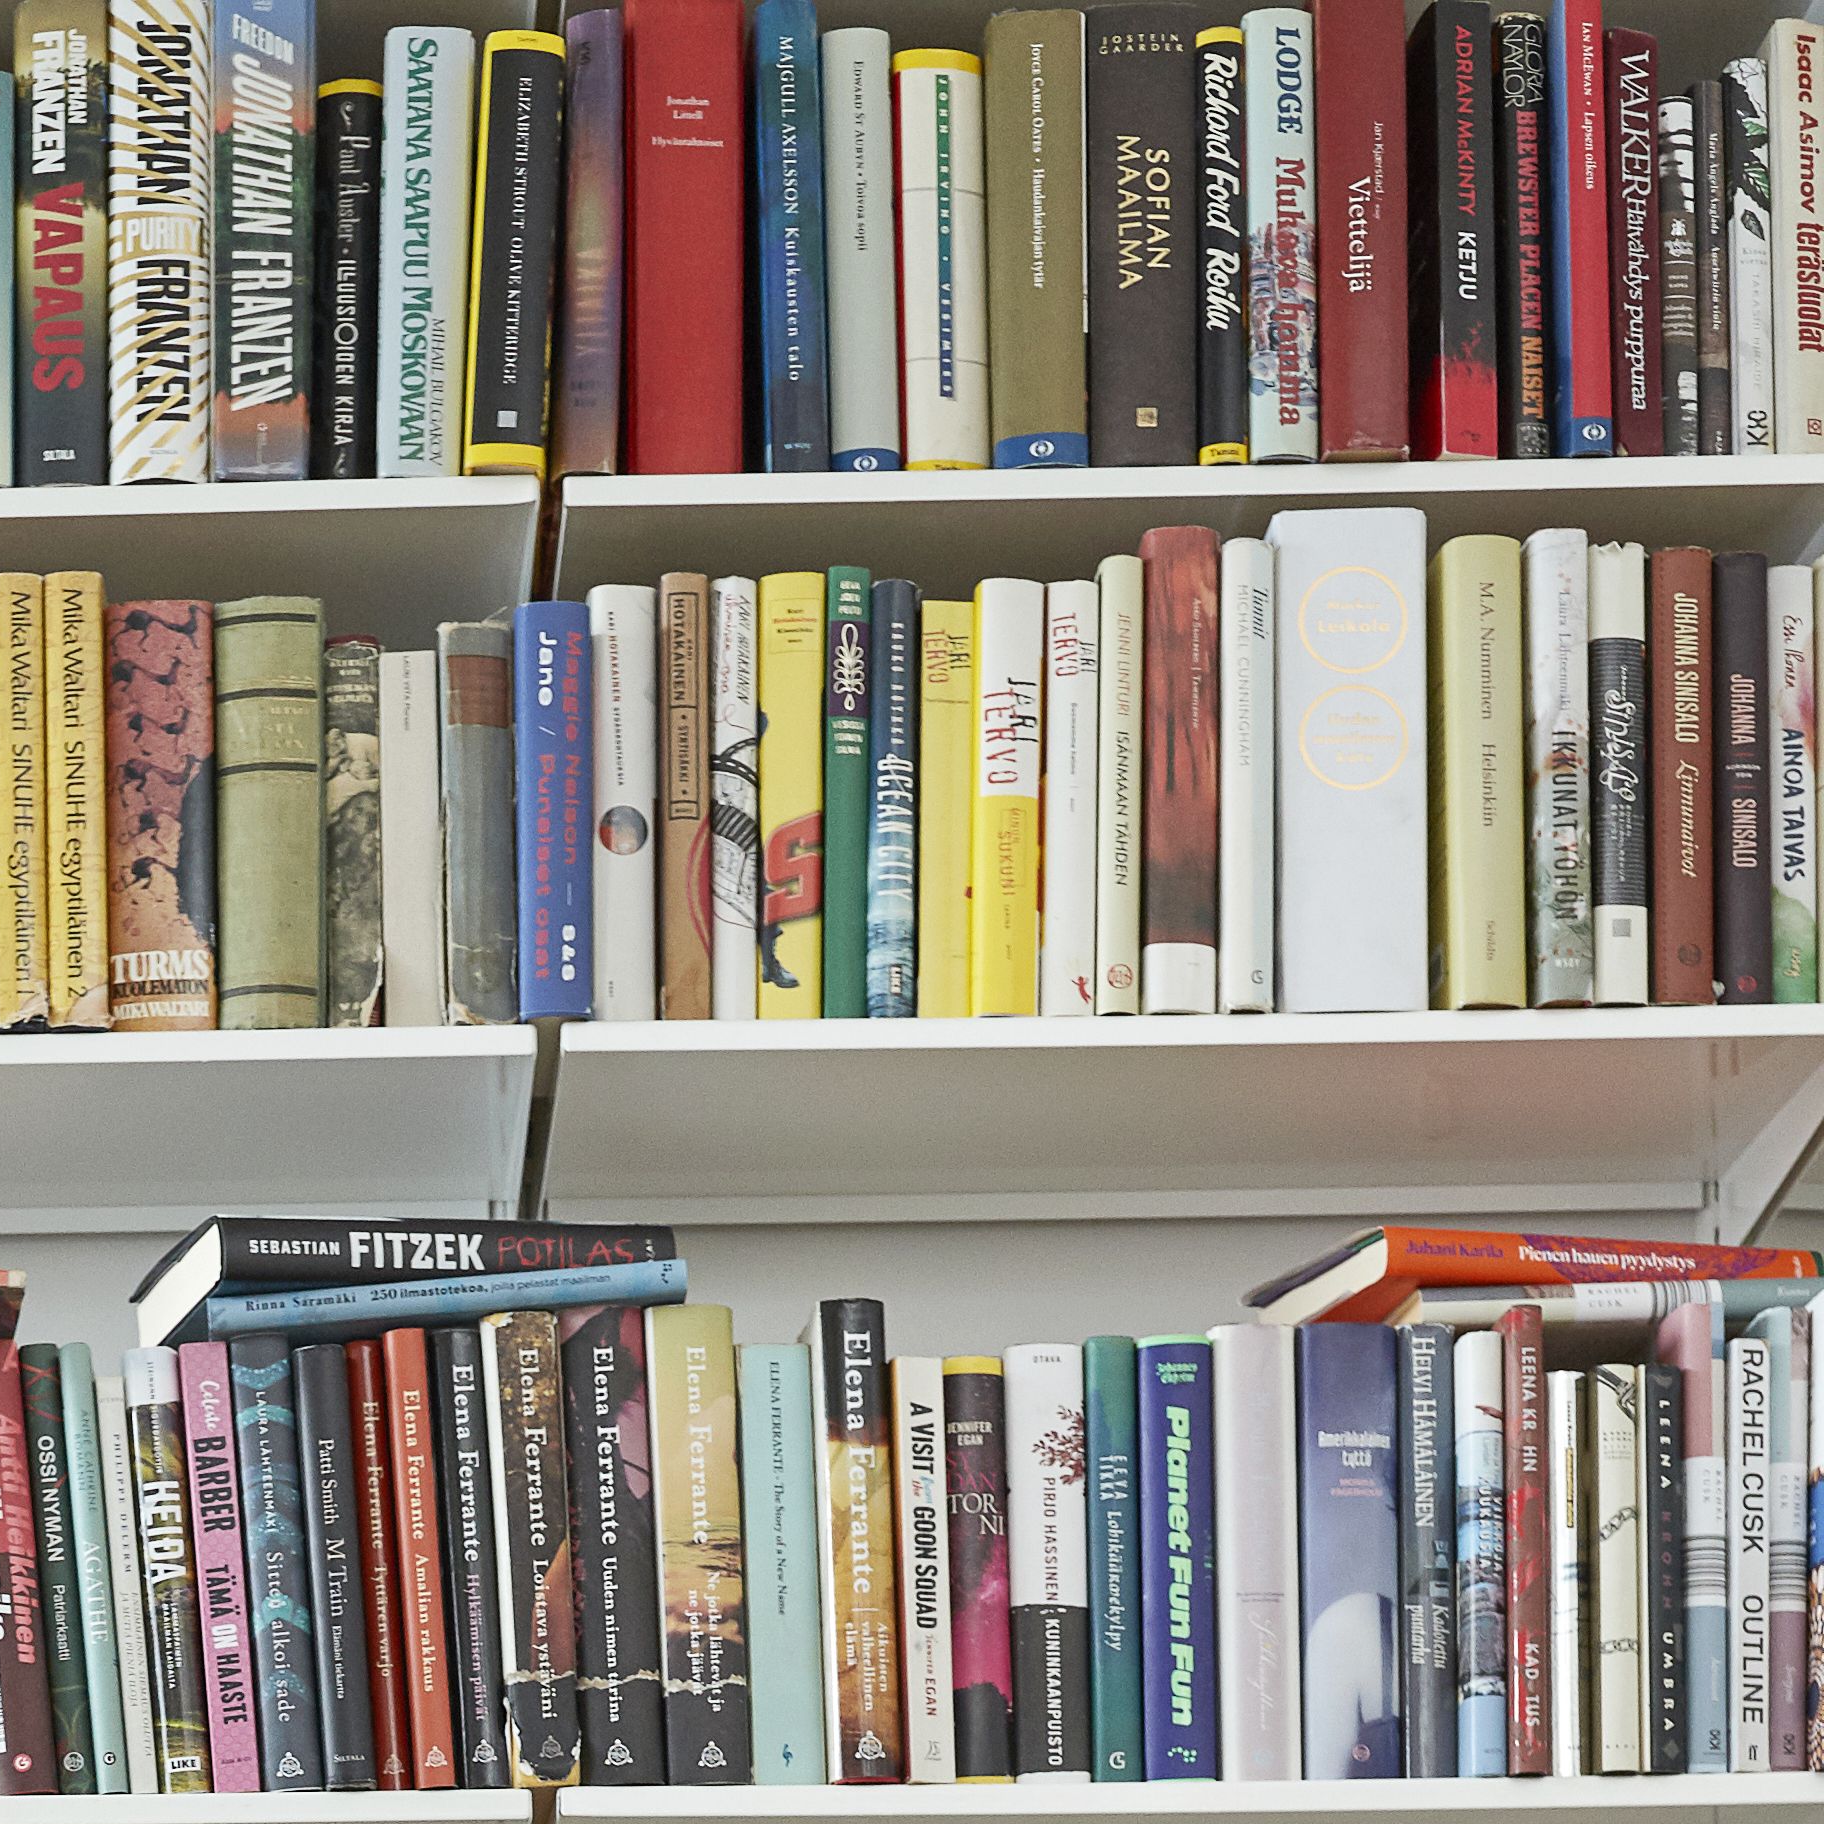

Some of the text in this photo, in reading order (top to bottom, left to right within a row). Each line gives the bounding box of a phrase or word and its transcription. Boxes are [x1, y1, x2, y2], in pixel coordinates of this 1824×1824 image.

[32, 32, 65, 174] FRANZEN
[65, 28, 88, 125] JONATHAN
[1204, 52, 1240, 331] Richard Ford Roihu
[1455, 25, 1478, 300] ADRIAN McKINTY KETJU
[1797, 34, 1824, 352] Isaac Asimov teräsluolat
[32, 182, 85, 392] VAPAUS
[125, 217, 201, 252] PURITY
[136, 21, 190, 422] JONATHAN FRANZEN
[399, 36, 439, 461] SAATANA SAAPUU MOSKOVAAN
[1117, 135, 1143, 289] MAAILMA
[1145, 147, 1171, 270] SOFIAN
[61, 588, 89, 998] Mika Waltari SINUHE egyptiläinen 2
[1115, 613, 1131, 886] JENNI LINTURI ISÄNMAAN TÄHDEN
[1674, 593, 1699, 877] JOHANNA SINISALO Linnunaivot
[112, 951, 211, 984] TURMS
[248, 1230, 634, 1271] SEBASTIAN FITZEK POTILAS
[593, 1347, 623, 1722] Elena Ferrante Uuden nimen tarina
[1165, 1406, 1192, 1552] Planet
[1168, 1555, 1193, 1638] Fun
[1741, 1349, 1765, 1725] RACHEL CUSK OUTLINE
[1043, 1477, 1063, 1767] PIRJO HASSINEN KUNINKAANPUISTO
[1171, 1643, 1195, 1727] Fun
